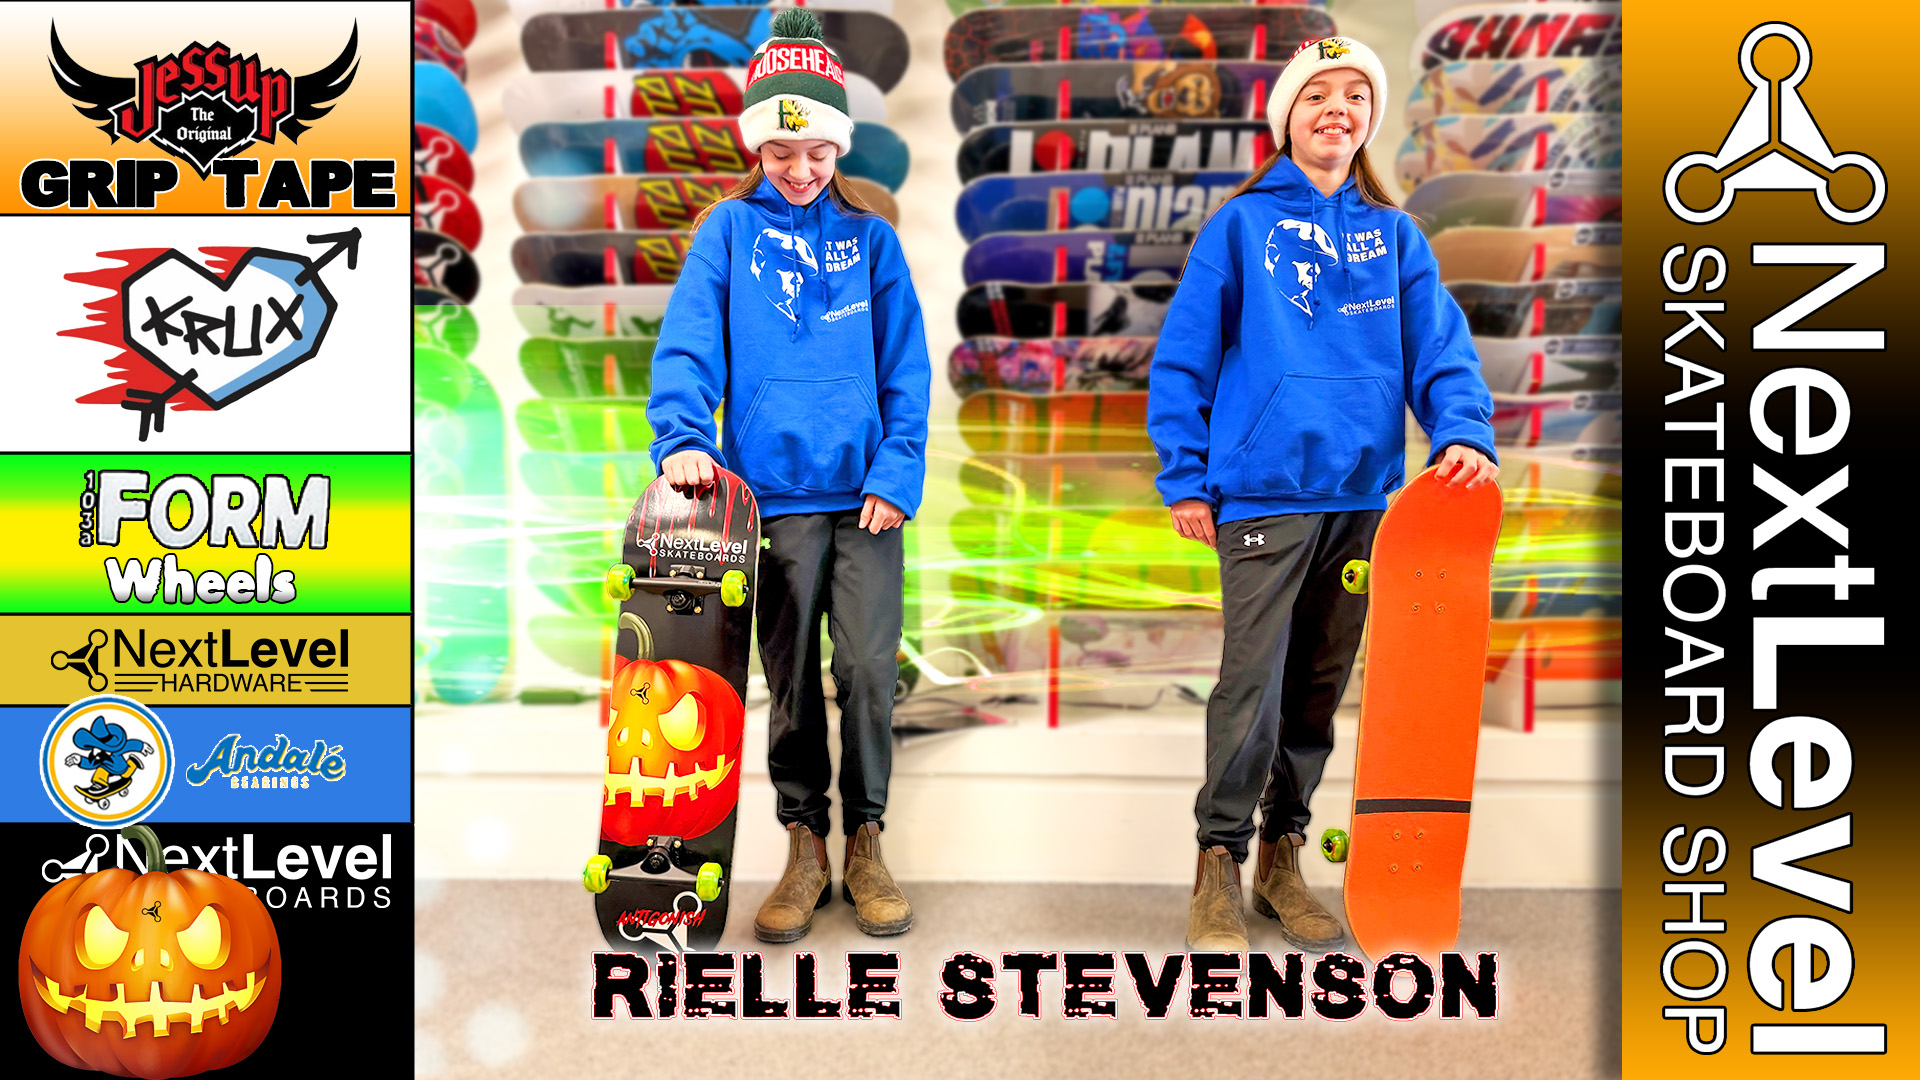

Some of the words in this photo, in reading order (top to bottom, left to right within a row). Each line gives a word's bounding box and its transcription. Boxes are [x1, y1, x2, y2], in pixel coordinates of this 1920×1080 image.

[1354, 228, 1382, 243] WAS
[1374, 237, 1384, 248] A
[835, 236, 858, 251] WAS
[825, 251, 848, 262] ALL
[852, 244, 859, 255] A
[825, 252, 861, 272] DREAM
[1348, 296, 1395, 311] NextLevel
[659, 532, 748, 555] NextLevel
[658, 549, 746, 564] SKATEBOARDS
[615, 908, 707, 929] ANTIGONISH
